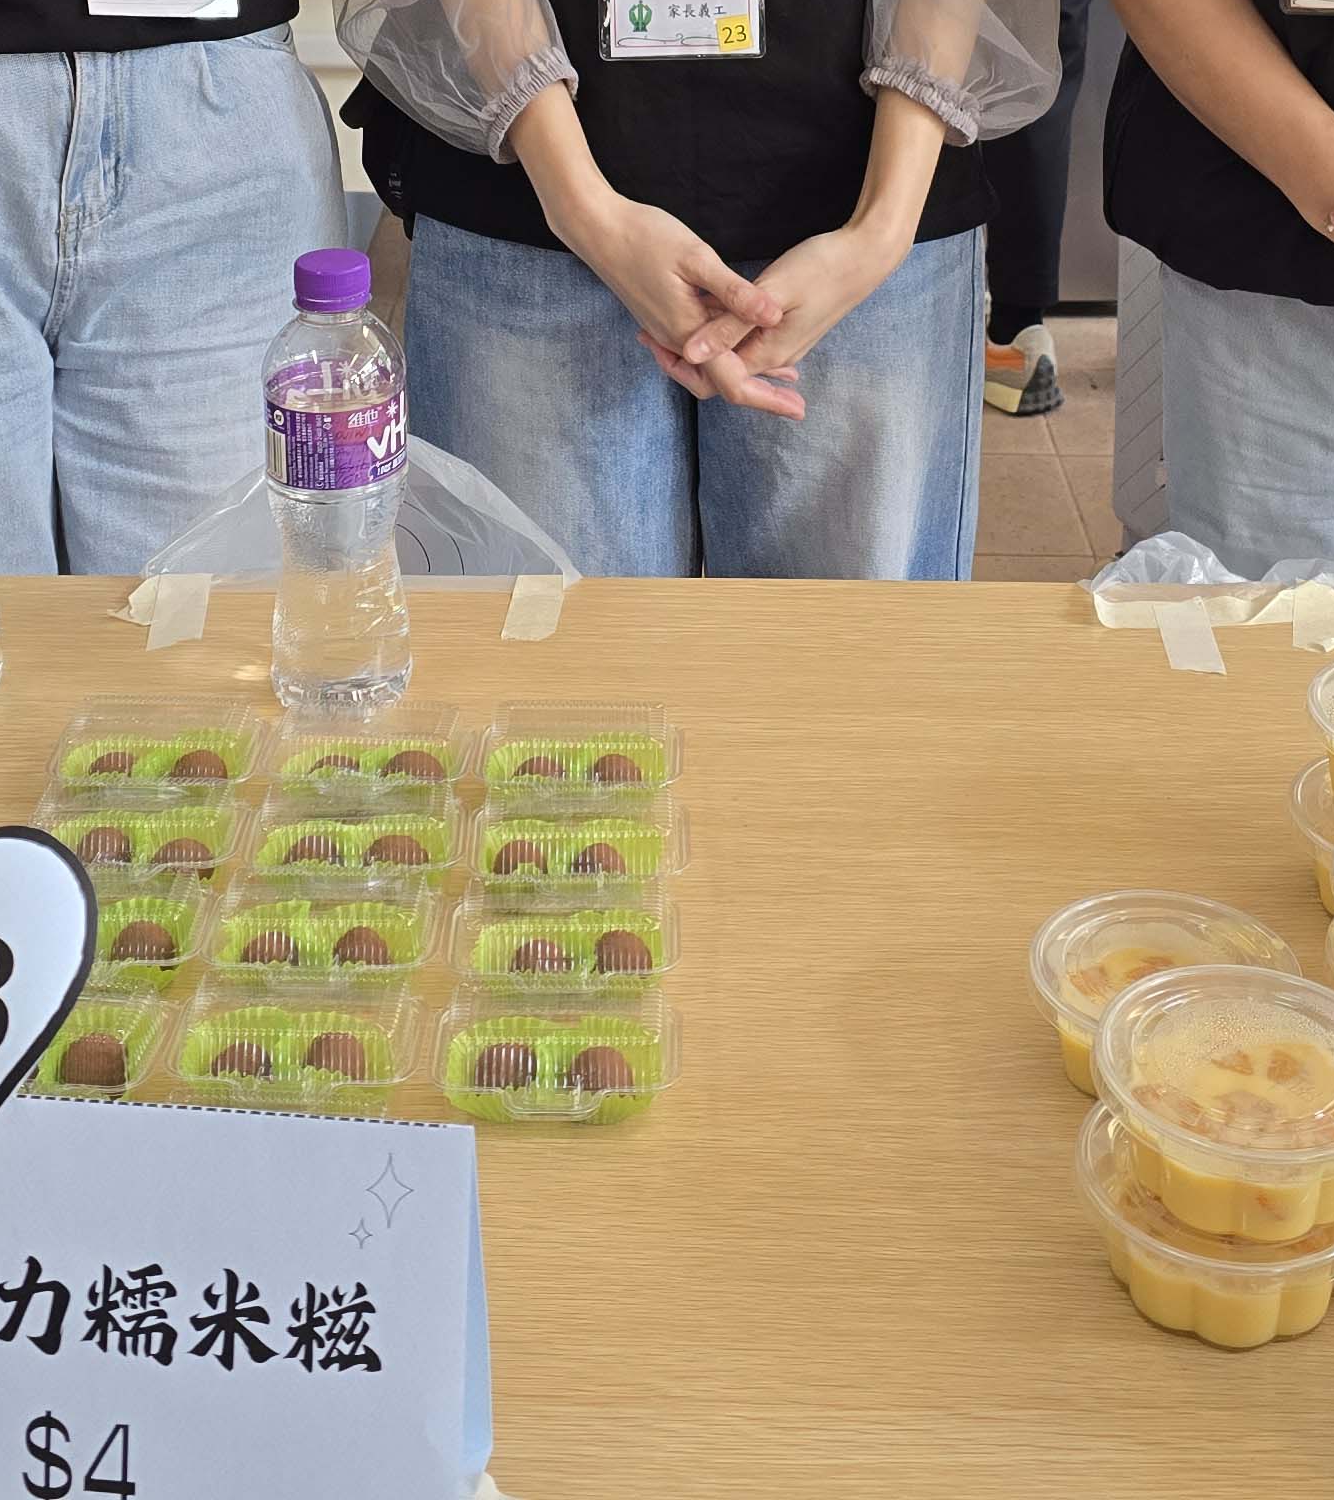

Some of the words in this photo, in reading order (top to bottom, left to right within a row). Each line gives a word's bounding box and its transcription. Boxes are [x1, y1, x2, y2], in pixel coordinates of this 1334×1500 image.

[668, 2, 727, 19] 家長義工
[722, 24, 748, 45] 23
[21, 1411, 137, 1500] $4
